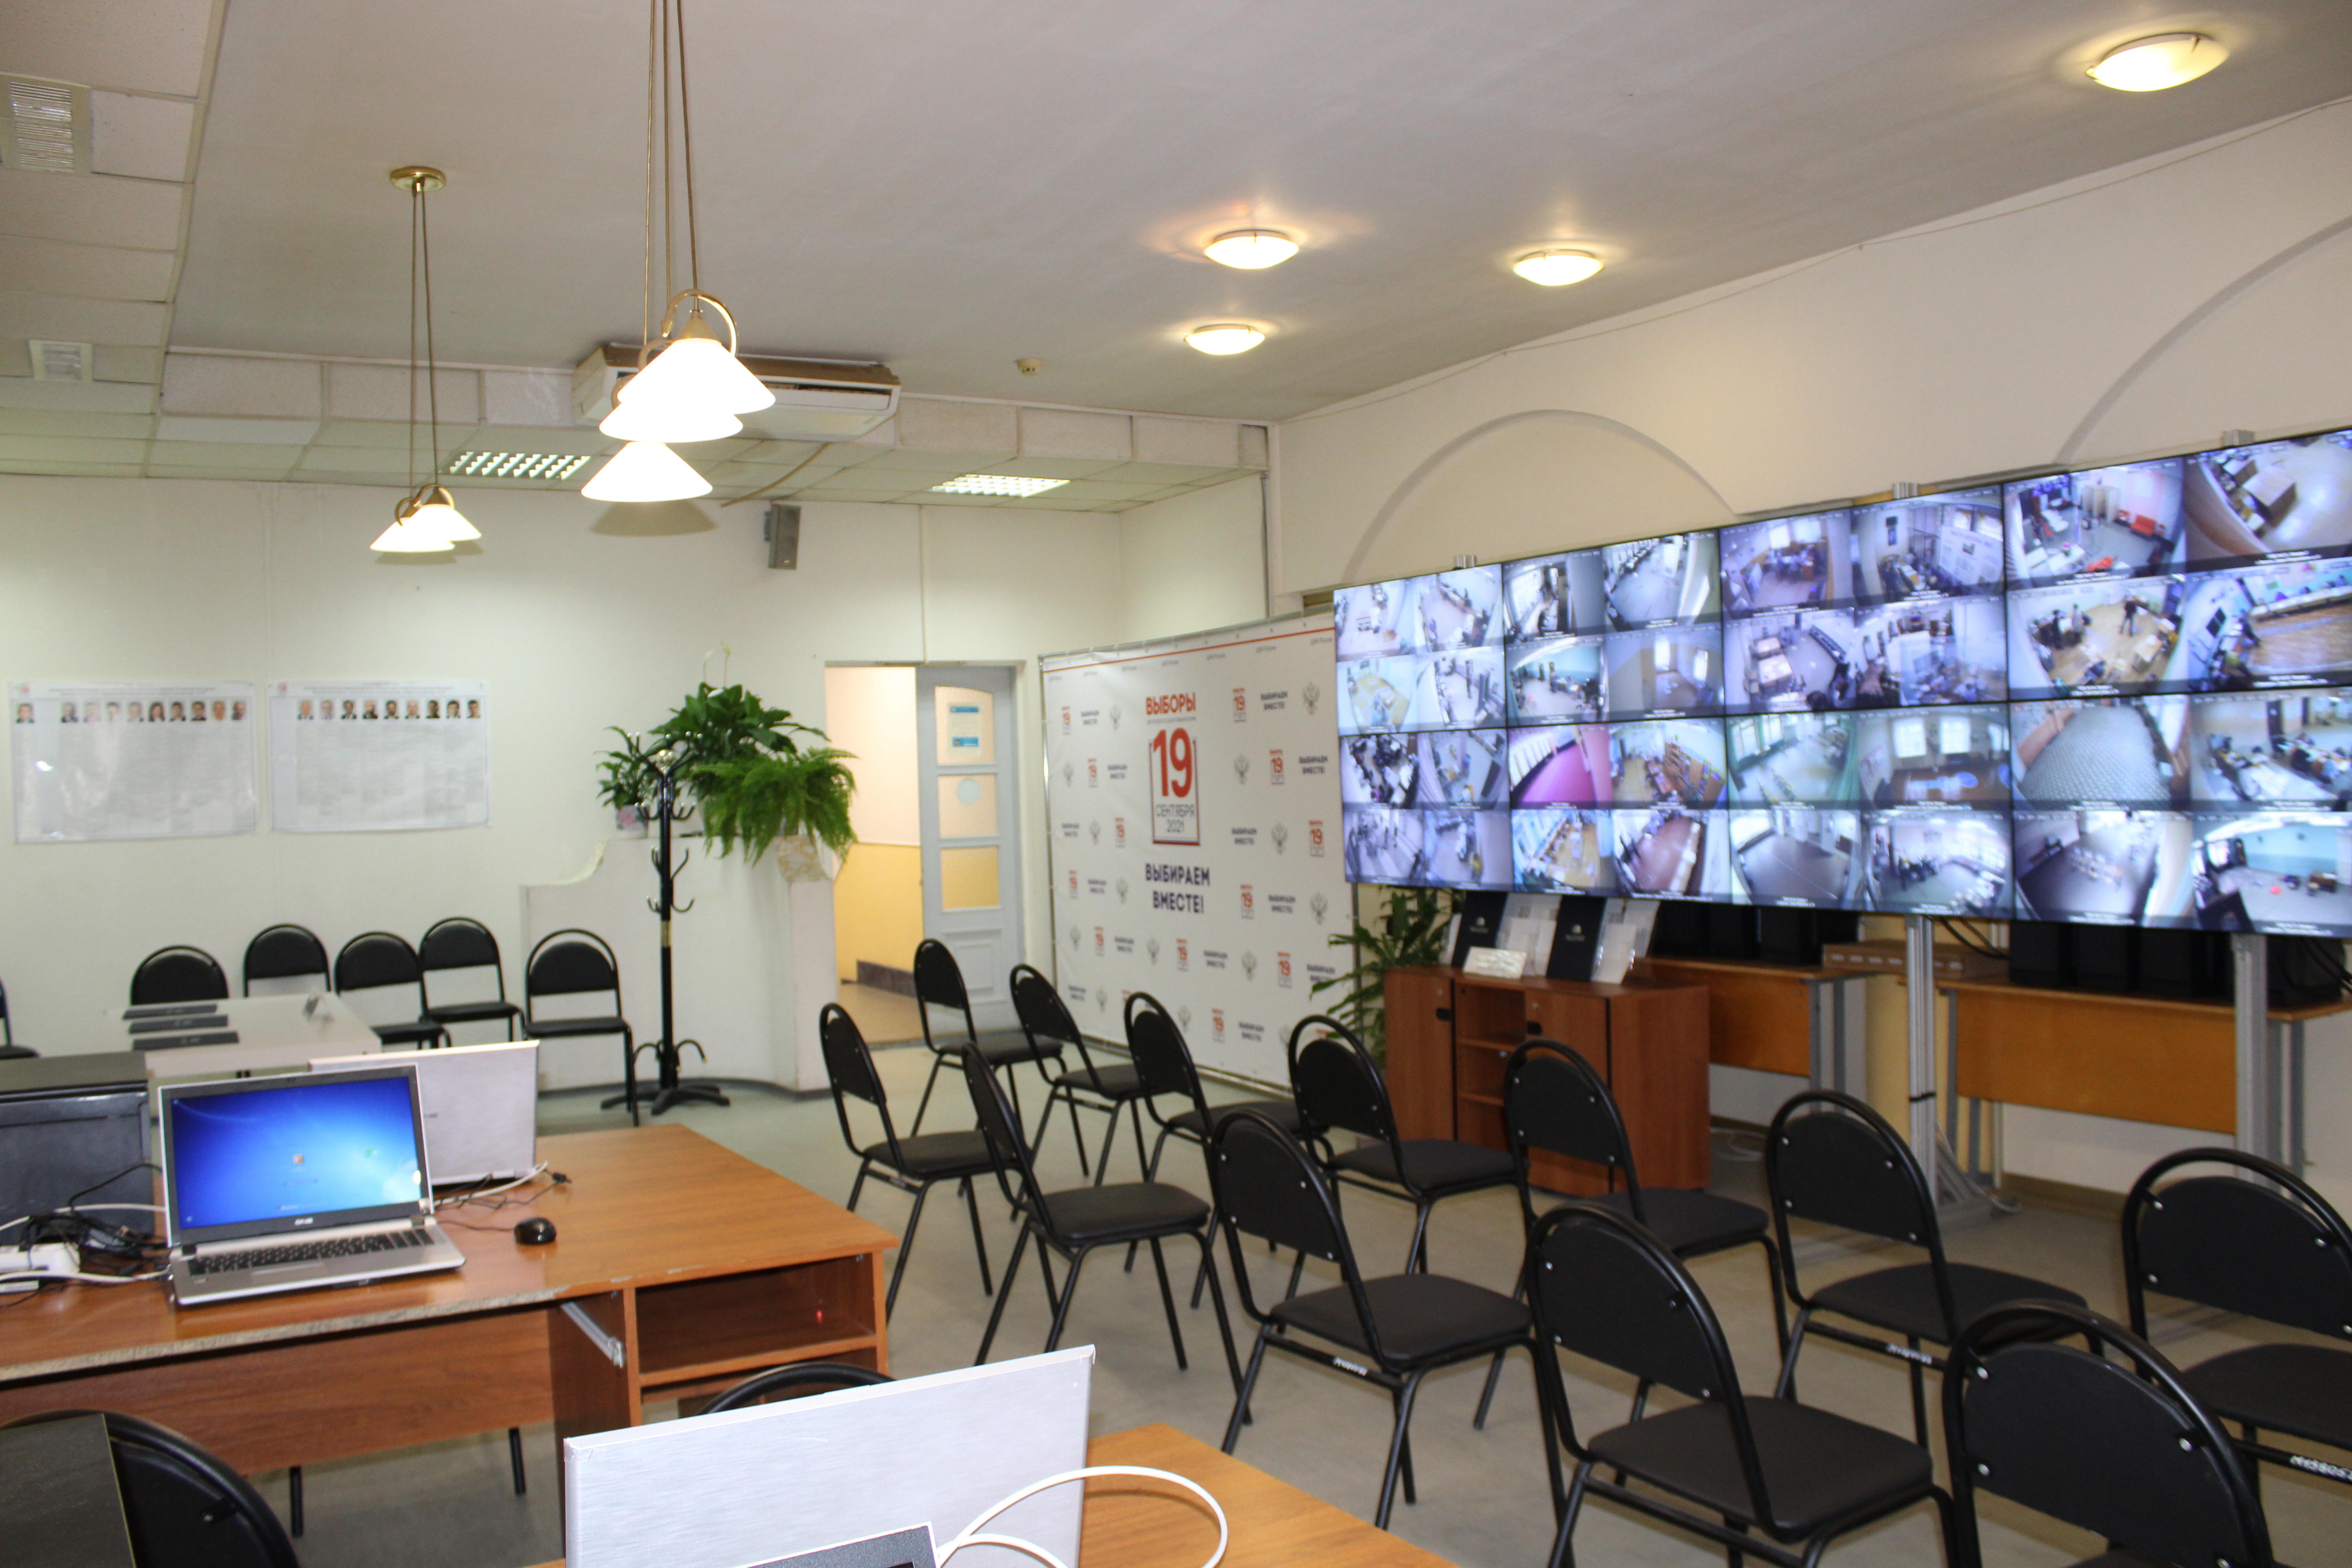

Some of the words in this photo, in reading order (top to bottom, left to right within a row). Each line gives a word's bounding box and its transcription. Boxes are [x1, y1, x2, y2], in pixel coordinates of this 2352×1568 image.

[1146, 692, 1196, 715] ВЫБОРЫ
[1234, 695, 1245, 711] 19
[1152, 728, 1192, 798] 19
[1271, 757, 1283, 773] 19
[1156, 804, 1195, 817] СЕНТЯБРЯ
[1166, 819, 1185, 833] 2021
[1310, 828, 1323, 845] 19
[1145, 863, 1210, 886] ВЫБИРАЕМ
[1153, 890, 1204, 914] ВМЕСТЕ!
[1241, 893, 1252, 908] 19
[1278, 960, 1290, 976] 19
